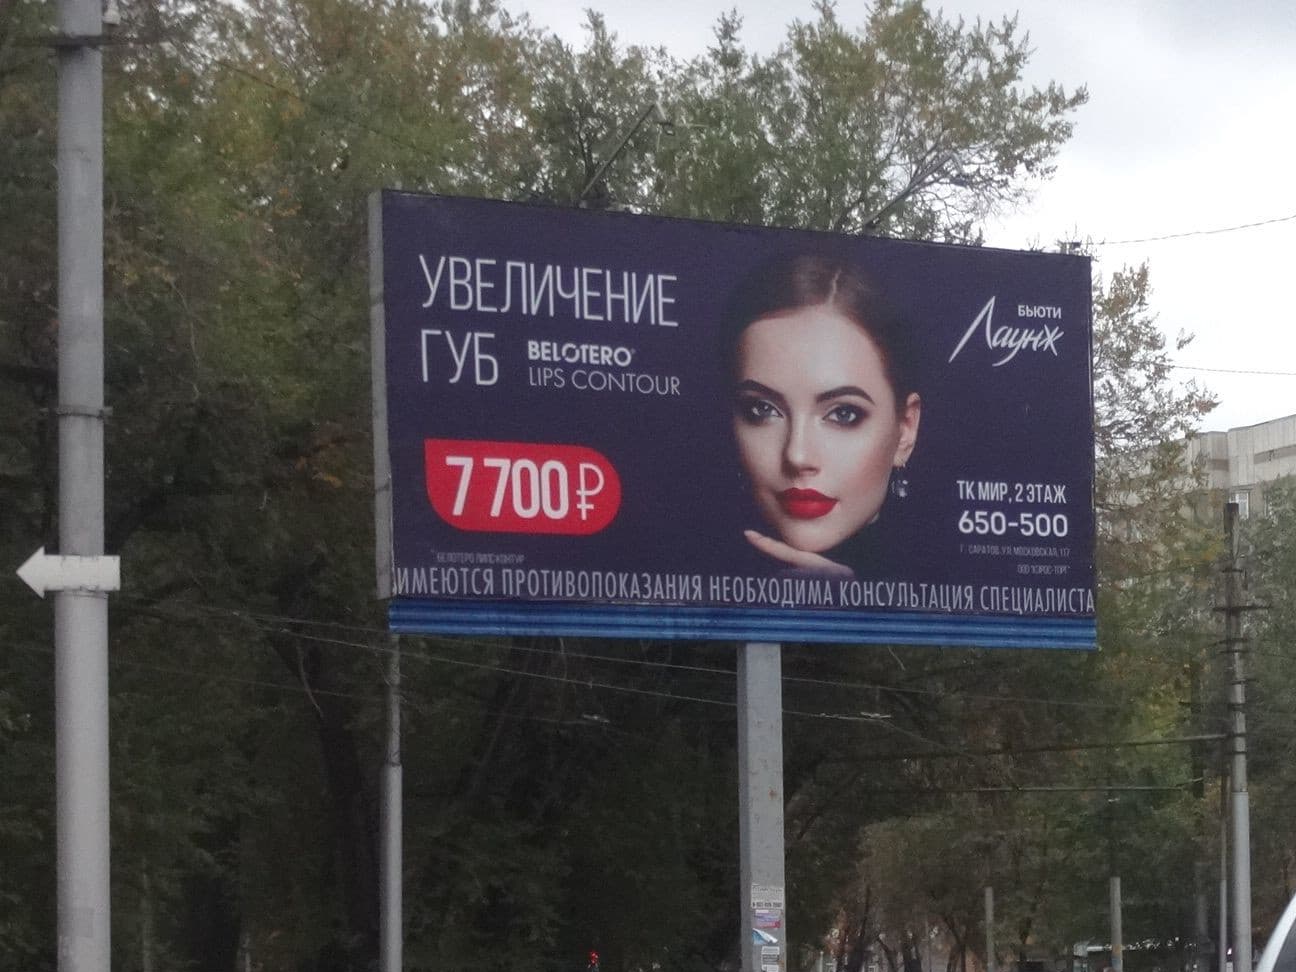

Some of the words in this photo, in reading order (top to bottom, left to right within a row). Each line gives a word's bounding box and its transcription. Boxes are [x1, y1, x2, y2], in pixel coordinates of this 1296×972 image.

[419, 254, 680, 328] УВЕЛИЧЕНИЕ
[1017, 304, 1063, 320] БЬЮТИ
[948, 296, 1065, 367] Лаунж
[419, 328, 499, 386] ГУБ
[527, 340, 632, 367] BELOTERO
[528, 366, 566, 389] LIPS
[571, 369, 681, 396] CONTOUR
[956, 480, 976, 501] ТК
[1014, 482, 1024, 503] 2
[1026, 483, 1067, 504] ЭТАЖ
[958, 510, 1068, 537] 650-500
[397, 567, 494, 595] ИМЕЮТСЯ
[501, 568, 702, 600] ПРОТИВОПОКАЗАНИЯ
[709, 575, 834, 609] НЕОБХОДИМА
[839, 580, 974, 613] КОНСУЛЬТАЦИЯ
[980, 585, 1095, 615] СПЕЦИАЛИСТА
